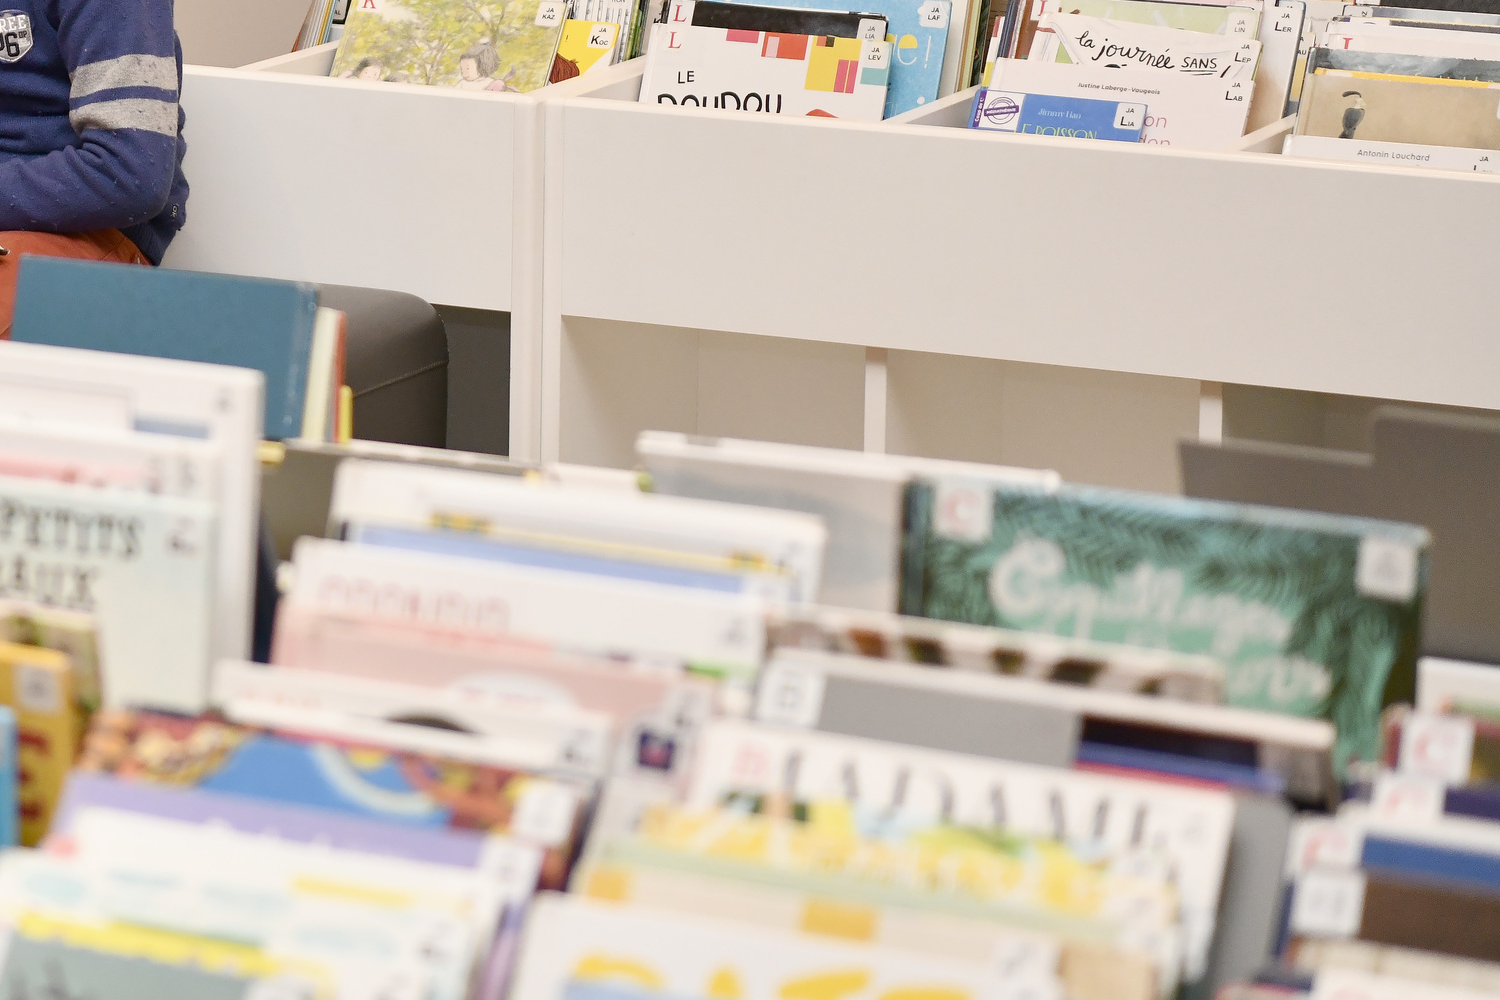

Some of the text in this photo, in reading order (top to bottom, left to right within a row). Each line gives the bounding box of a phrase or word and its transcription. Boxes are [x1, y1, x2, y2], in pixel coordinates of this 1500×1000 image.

[673, 5, 687, 22] L
[1274, 22, 1292, 33] LER
[591, 35, 609, 46] KOC
[668, 31, 682, 49] L
[1075, 30, 1217, 69] la journée SANS
[678, 70, 695, 84] LE
[1078, 82, 1100, 90] Justine
[1225, 91, 1243, 102] LAB
[1120, 116, 1135, 127] LIA
[1357, 149, 1431, 162] Antonin Louchard
